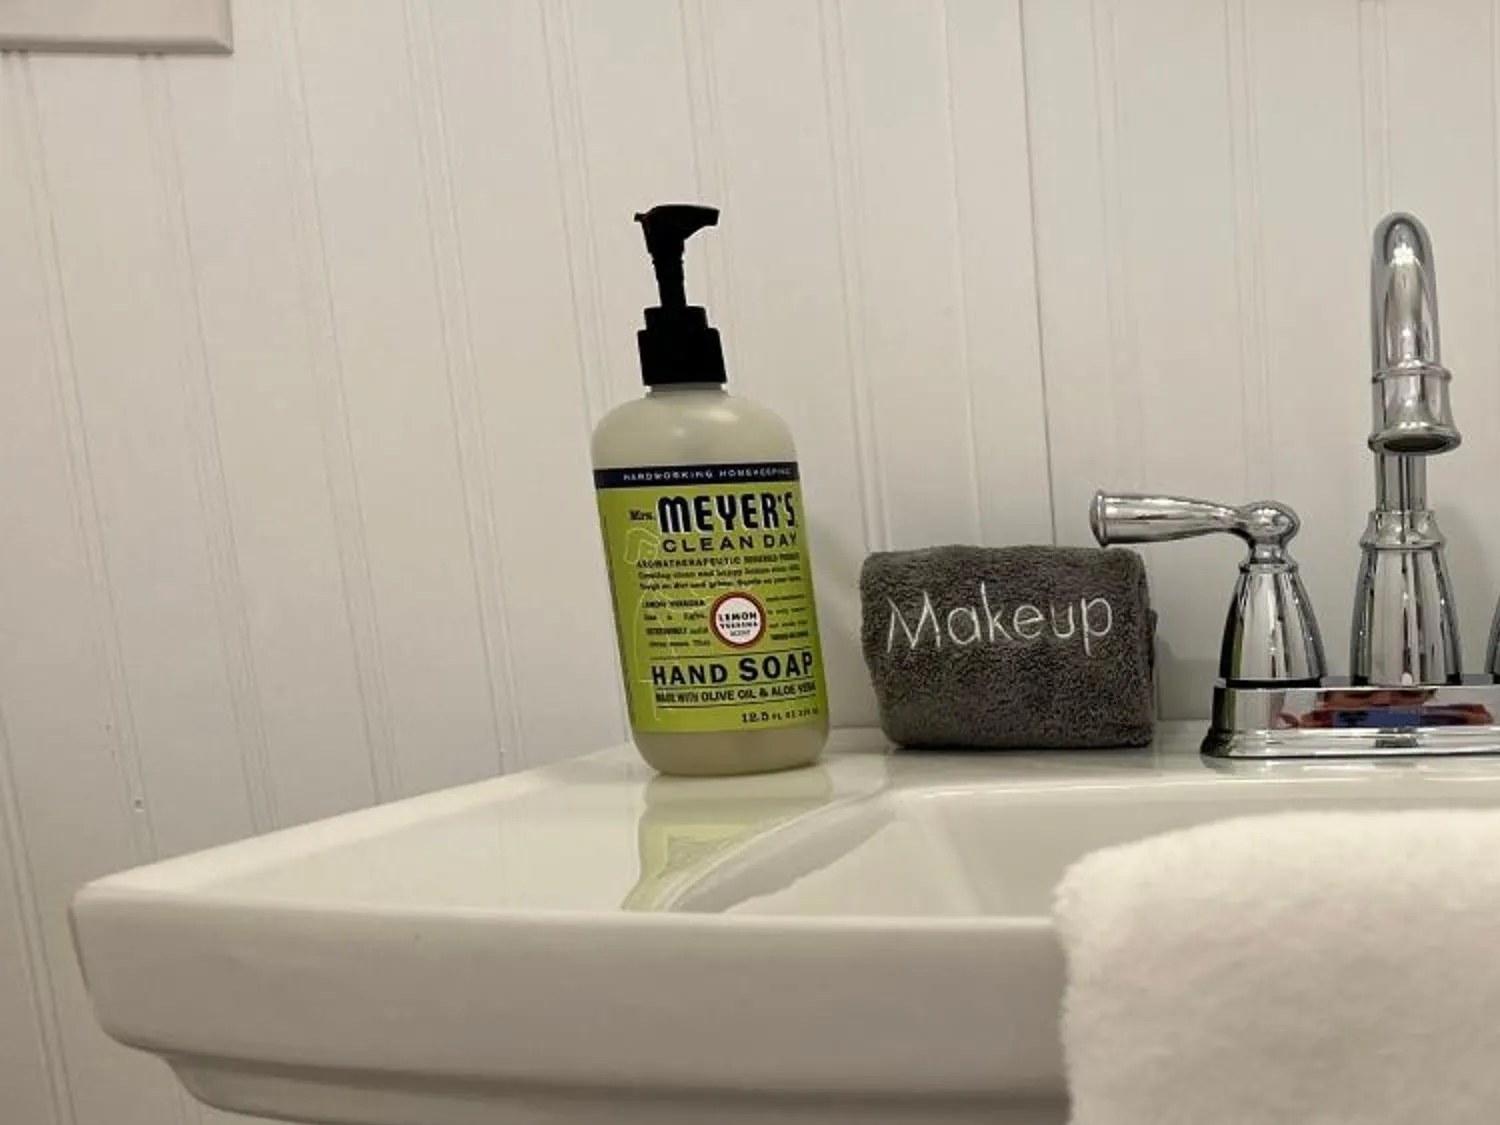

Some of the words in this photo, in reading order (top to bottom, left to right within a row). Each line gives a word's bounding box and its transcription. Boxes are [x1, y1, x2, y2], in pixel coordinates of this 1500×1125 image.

[623, 469, 714, 481] HARDWORKING
[657, 491, 796, 534] MEYER'S
[662, 535, 754, 553] CLEAN
[763, 532, 798, 549] DAY
[718, 610, 758, 623] LEMON
[886, 581, 1113, 657] Makeup
[651, 662, 728, 686] HAND
[738, 650, 813, 682] SOAP
[701, 690, 735, 702] OLIVE
[737, 688, 757, 701] OIL
[759, 687, 769, 698] &
[771, 685, 796, 697] ALOE
